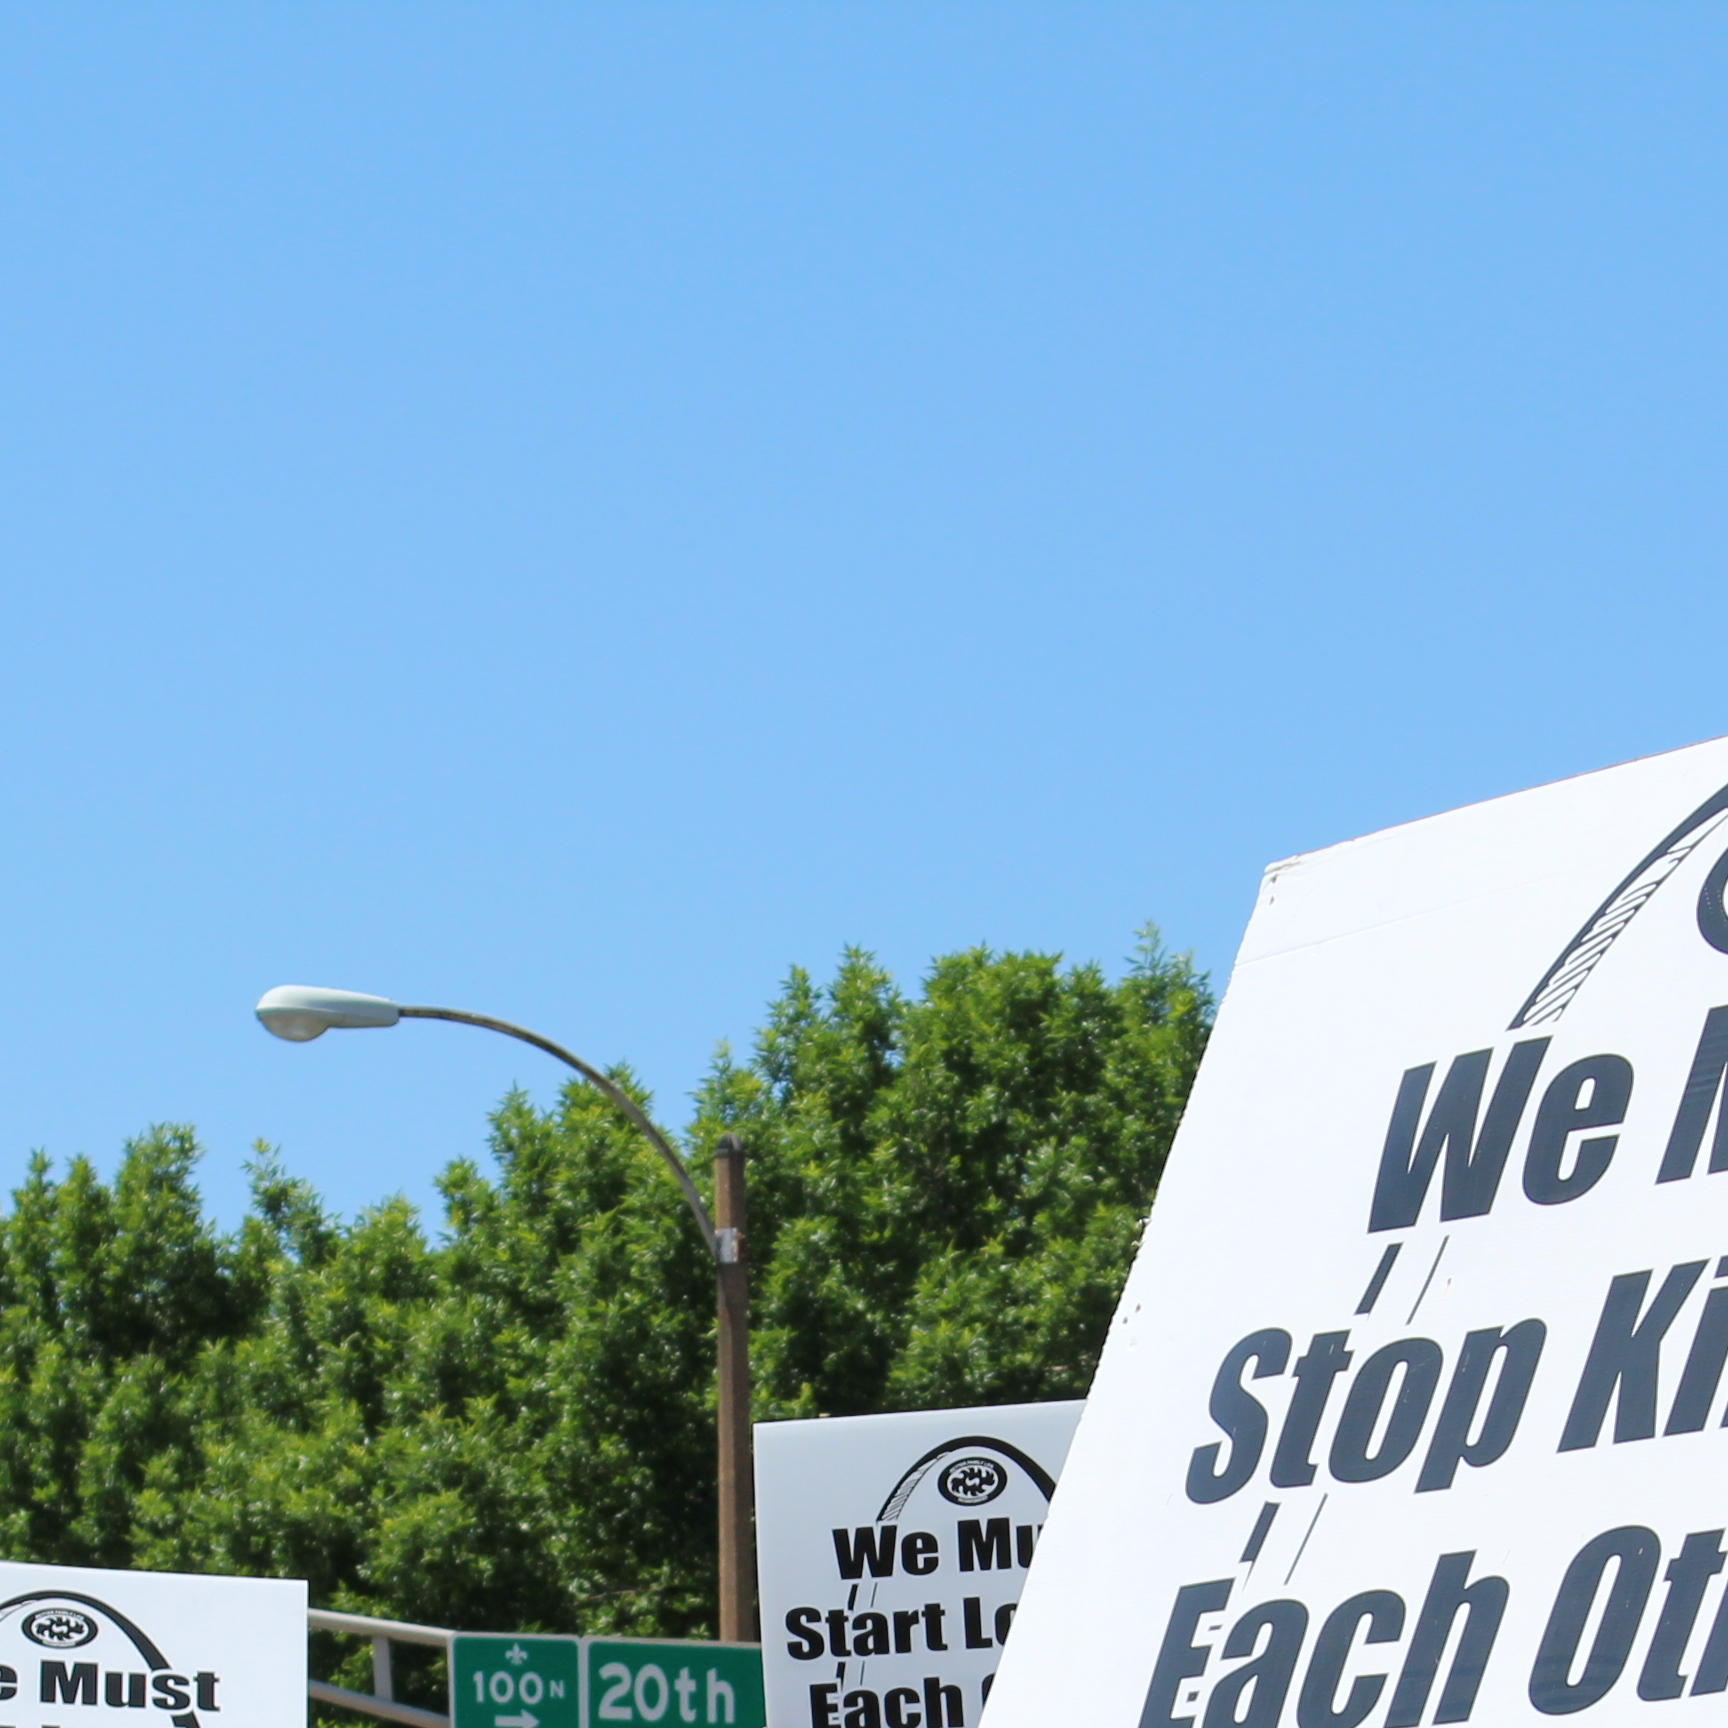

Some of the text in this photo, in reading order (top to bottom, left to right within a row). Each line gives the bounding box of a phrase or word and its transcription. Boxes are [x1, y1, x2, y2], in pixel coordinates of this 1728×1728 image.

[1369, 1035, 1634, 1235] We
[1184, 1315, 1547, 1506] Stop
[832, 1517, 1042, 1580] We Mu
[785, 1601, 947, 1661] Start
[39, 1660, 220, 1712] Must
[473, 1671, 564, 1705] 100 N
[598, 1662, 735, 1724] 20th
